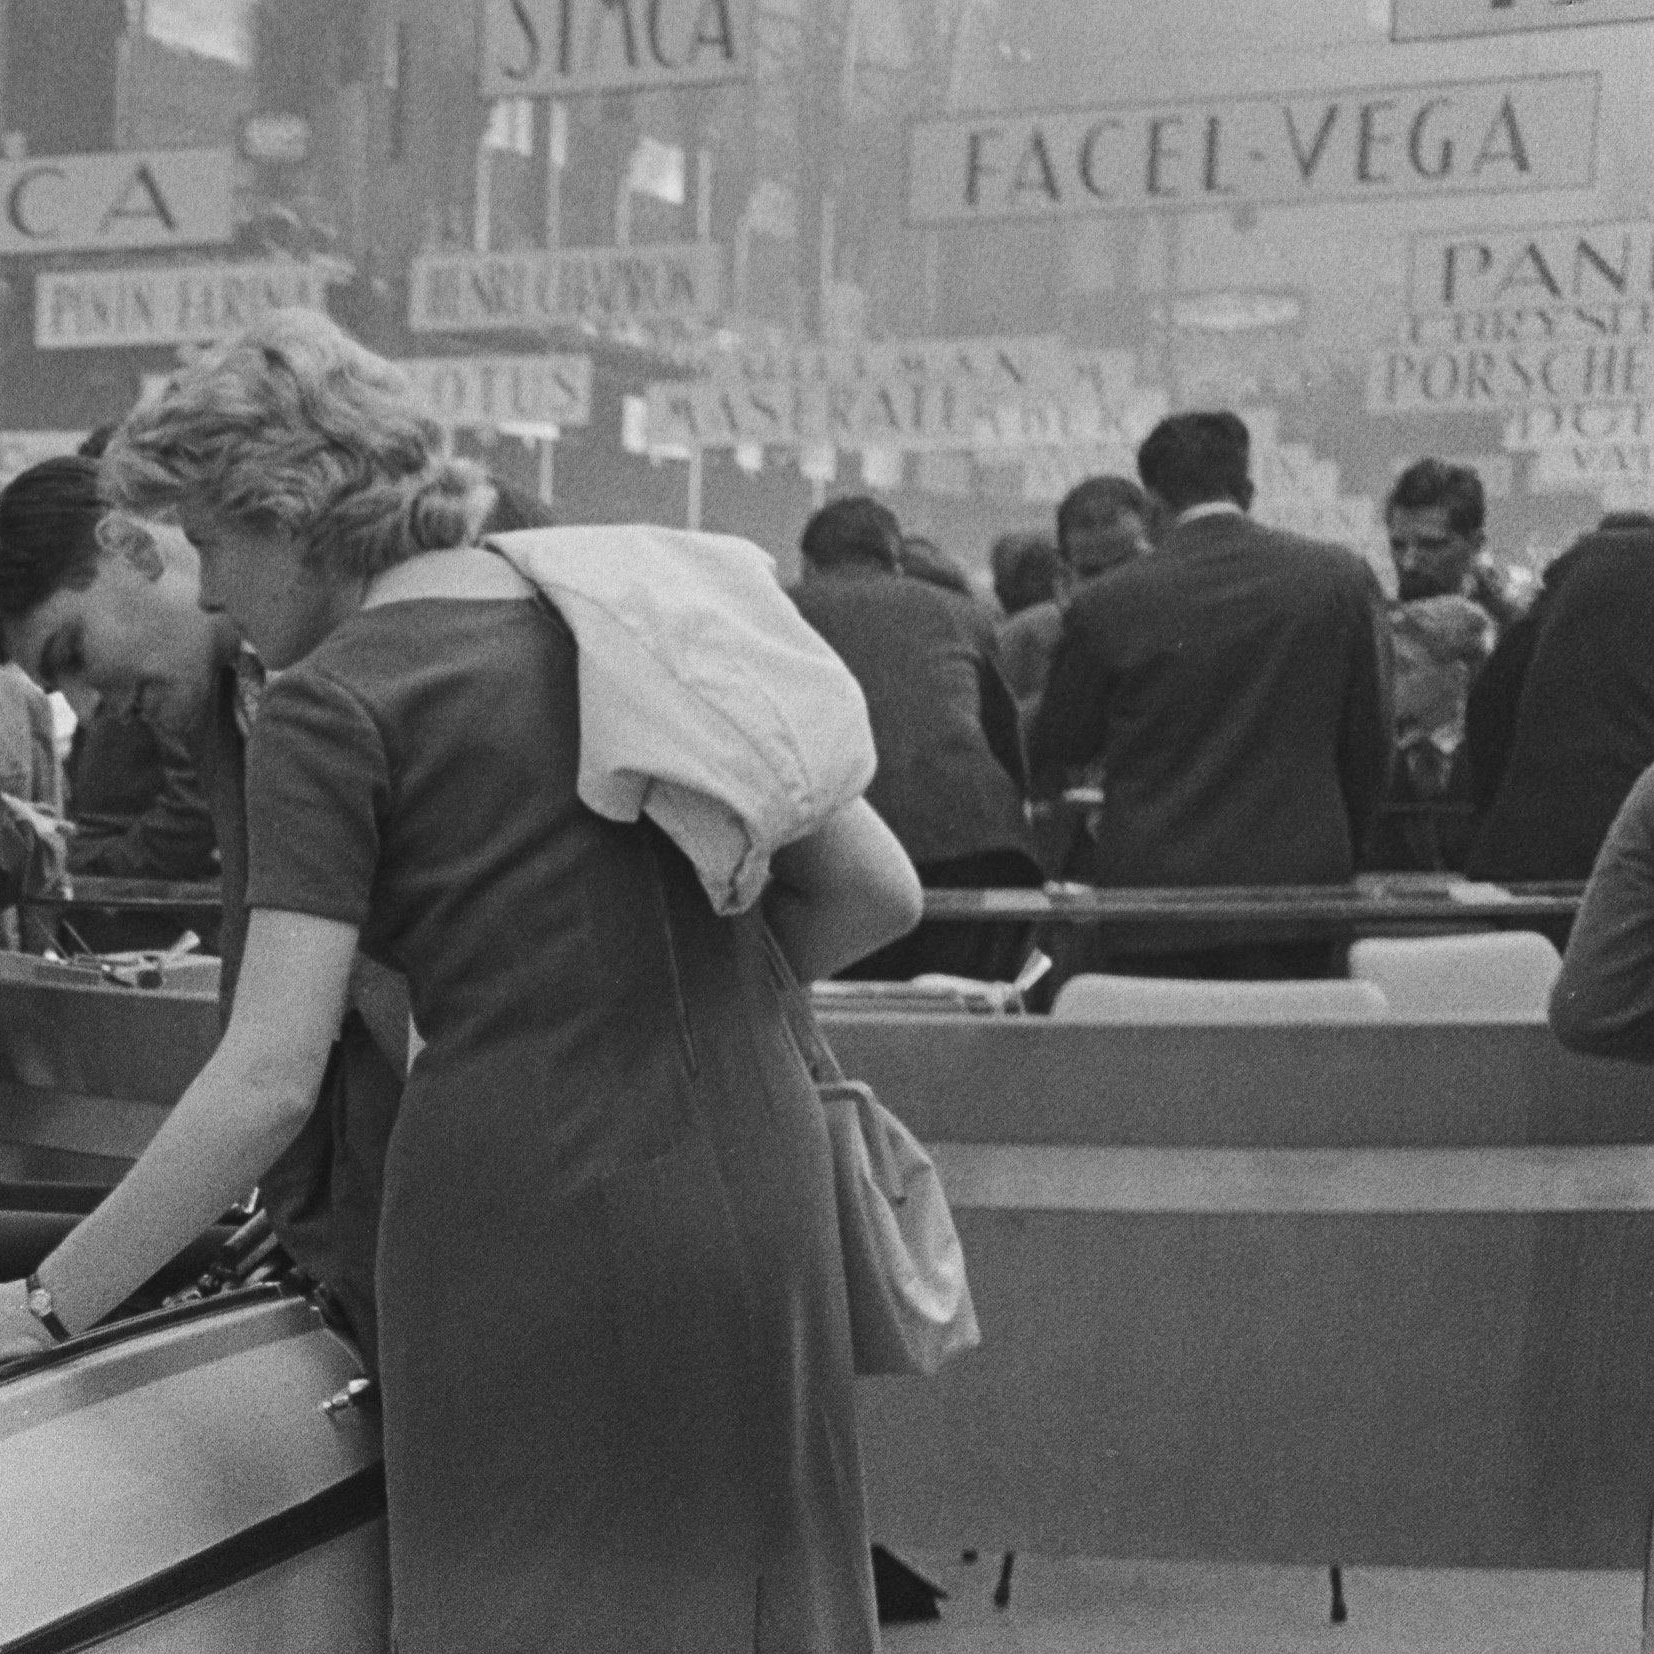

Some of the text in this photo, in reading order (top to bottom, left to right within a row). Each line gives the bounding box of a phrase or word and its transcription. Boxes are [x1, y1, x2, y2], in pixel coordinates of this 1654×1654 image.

[499, 0, 734, 79] SIMCA
[963, 94, 1532, 206] FACEL-VEGA
[1442, 232, 1654, 306] PAN
[430, 364, 582, 418] OTUS
[1385, 343, 1647, 404] PORSCHE
